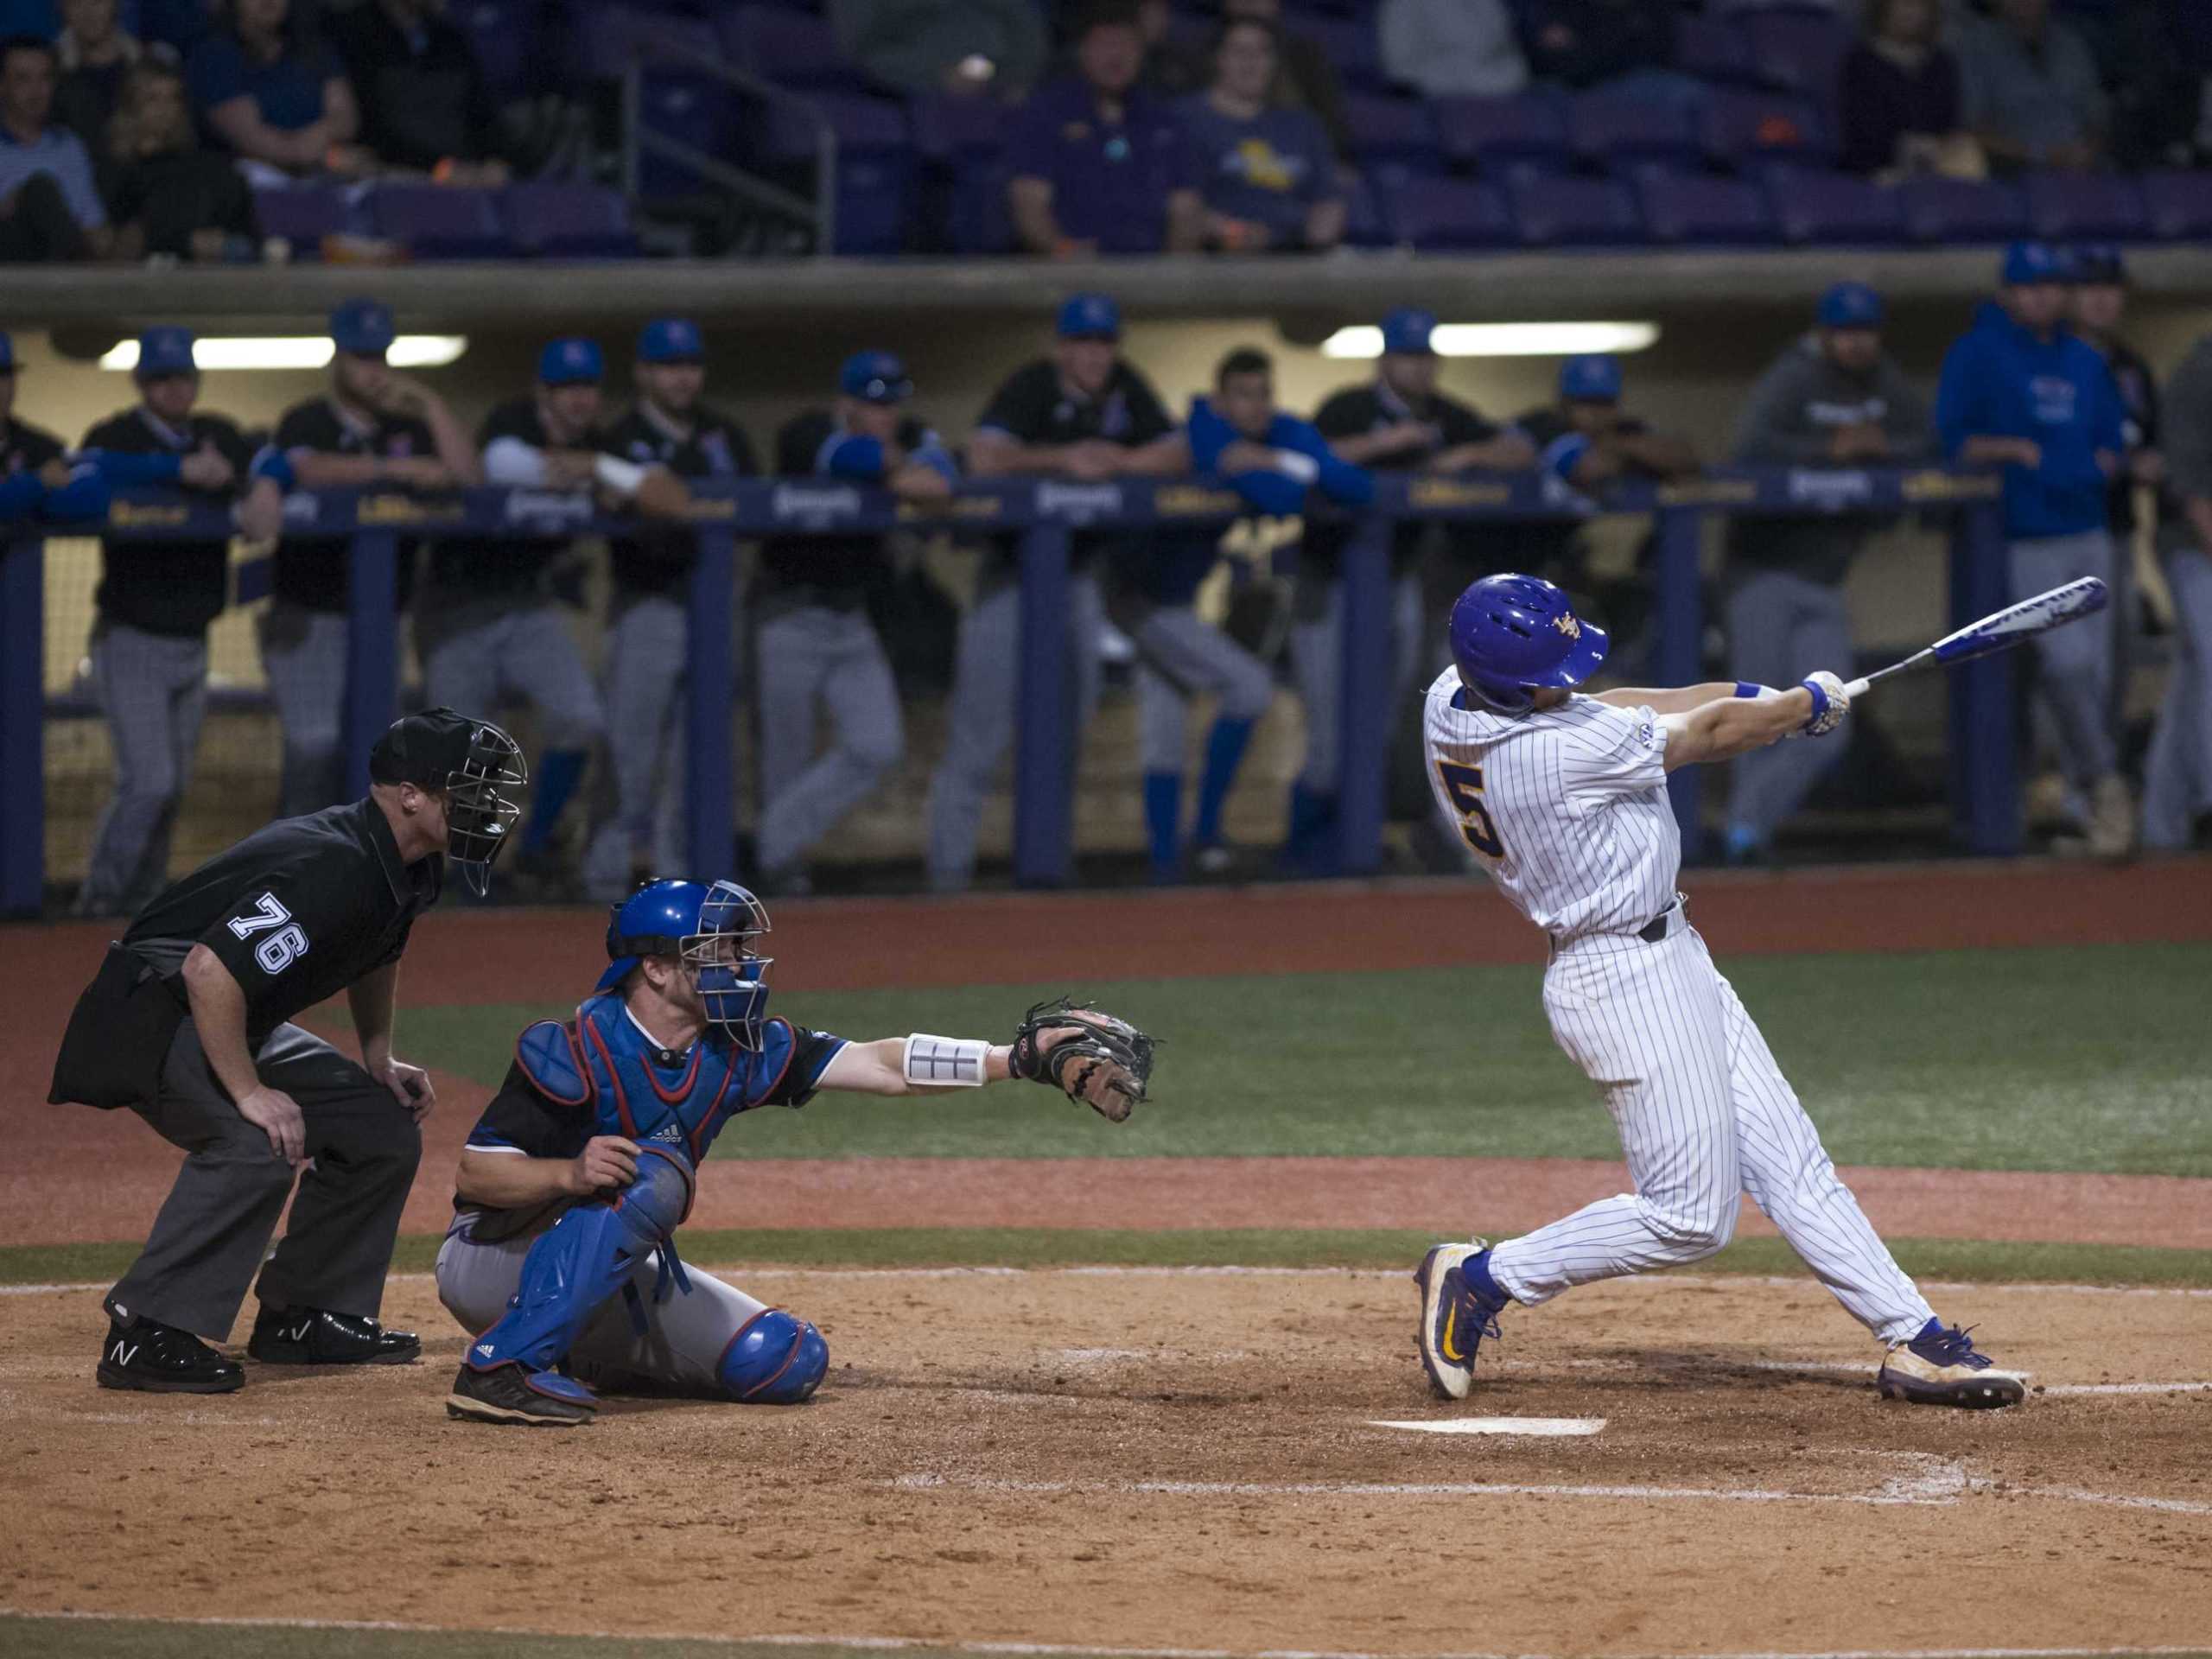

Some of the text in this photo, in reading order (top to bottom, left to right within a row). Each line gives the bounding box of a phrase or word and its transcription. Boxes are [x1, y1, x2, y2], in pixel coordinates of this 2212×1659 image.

[1592, 651, 1603, 661] 5
[1436, 760, 1505, 859] 5
[226, 892, 310, 975] 76
[111, 1340, 139, 1367] N
